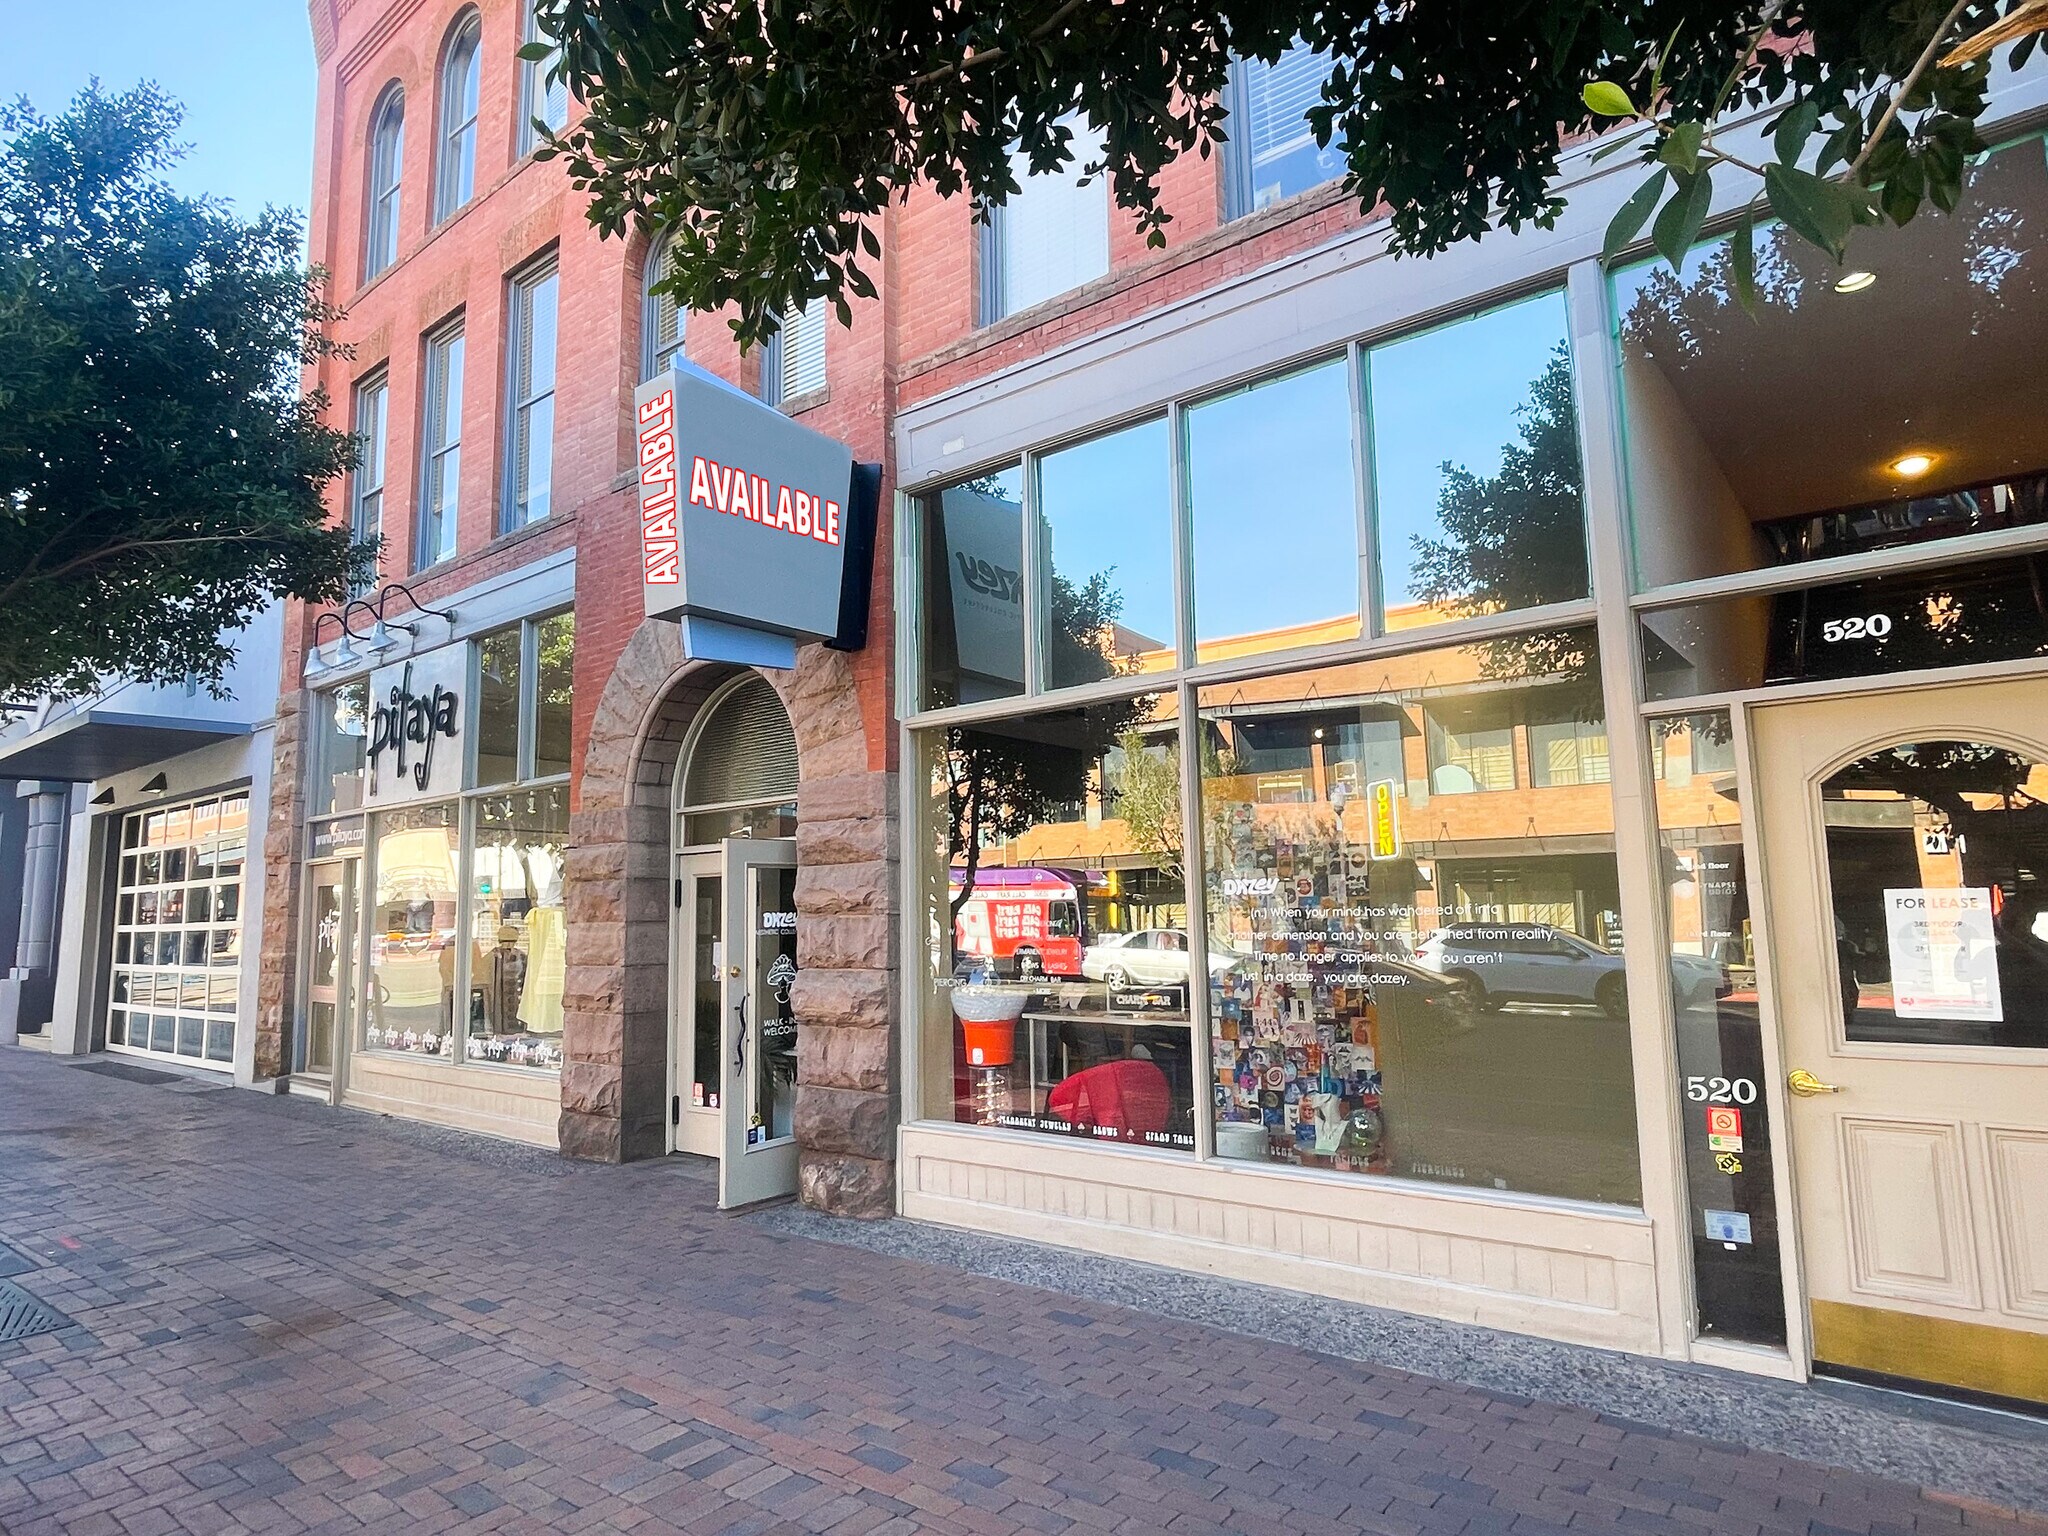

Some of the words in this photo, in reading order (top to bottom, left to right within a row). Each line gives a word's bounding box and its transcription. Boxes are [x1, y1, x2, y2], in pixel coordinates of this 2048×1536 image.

[640, 389, 679, 584] AVAILABLE
[689, 455, 840, 546] AVAILABLE
[1823, 613, 1892, 643] 520
[366, 660, 459, 797] pitaya
[1376, 783, 1393, 856] OPEN
[1271, 907, 1302, 918] When
[1305, 908, 1331, 920] your
[1331, 906, 1361, 917] mind
[1364, 905, 1386, 917] has
[1388, 904, 1453, 916] wandered
[1455, 903, 1472, 915] off
[1474, 903, 1500, 915] into
[1895, 898, 1926, 909] FOR
[1932, 897, 1979, 909] LEASE
[1226, 931, 1268, 941] another
[1271, 930, 1327, 941] dimension
[1330, 929, 1355, 941] and
[1357, 931, 1380, 943] you
[1383, 932, 1403, 941] are
[1410, 928, 1474, 941] detahed
[1477, 928, 1506, 941] from
[1253, 950, 1278, 962] Time
[1280, 952, 1296, 962] no
[1299, 950, 1336, 964] longer
[1340, 950, 1383, 965] applies
[1385, 951, 1398, 962] to
[1434, 953, 1459, 965] ou
[1462, 951, 1503, 965] aren't
[1241, 971, 1259, 983] just
[1263, 971, 1274, 982] in
[1275, 973, 1284, 982] a
[1323, 973, 1345, 985] you
[1347, 974, 1367, 984] are
[1370, 972, 1410, 987] dazey.
[1687, 1076, 1758, 1104] 520
